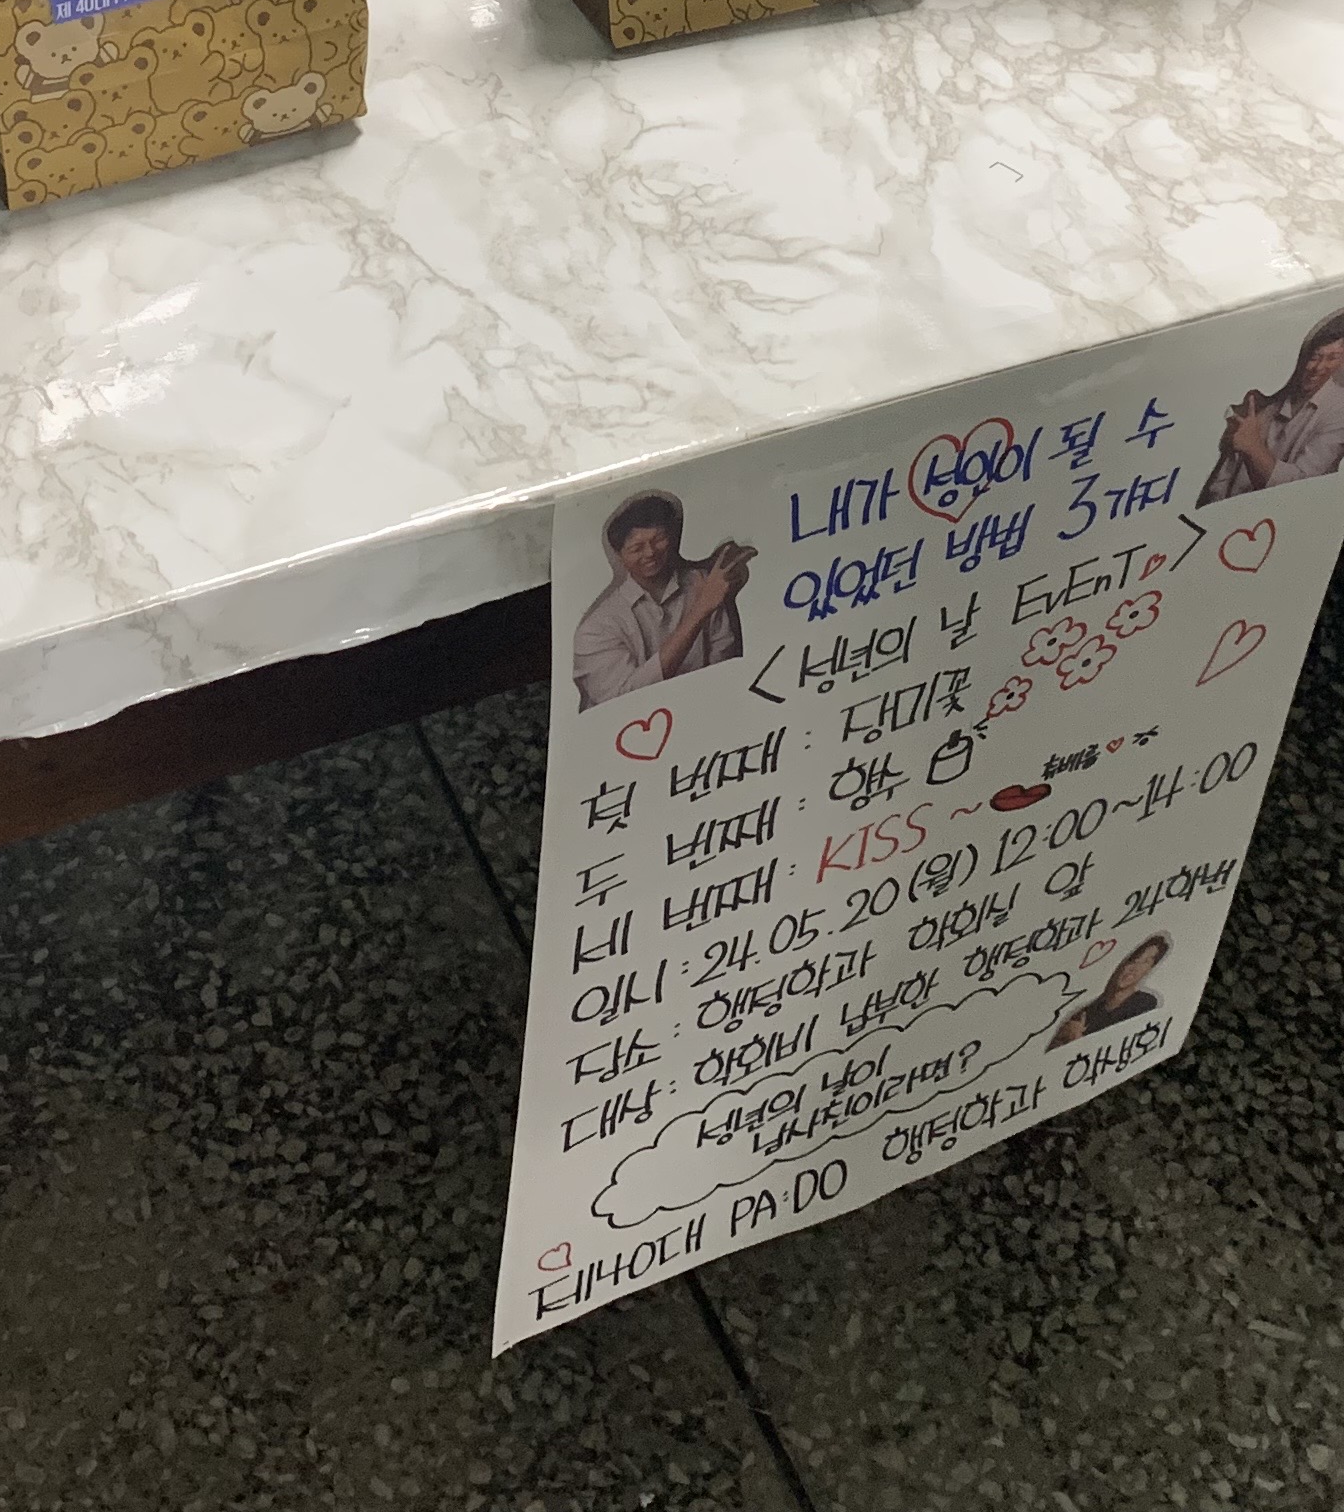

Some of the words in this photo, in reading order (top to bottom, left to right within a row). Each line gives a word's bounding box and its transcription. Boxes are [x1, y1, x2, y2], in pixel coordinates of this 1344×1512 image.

[55, 1, 72, 19] 제
[790, 468, 900, 543] 내가
[922, 426, 1043, 507] 성인이
[1048, 411, 1106, 470] 될
[1125, 397, 1175, 448] 수
[783, 538, 924, 622] 있었던
[945, 503, 1036, 573] 방법
[939, 591, 982, 650] 날
[580, 780, 637, 835] 첫
[840, 666, 973, 744] 장미꽃
[573, 909, 634, 975] 세
[814, 802, 933, 884] KISS
[574, 853, 628, 908] 두
[828, 751, 911, 811] 향수
[693, 1013, 820, 1088] 학회비
[841, 967, 940, 1038] 납부한
[962, 906, 1103, 983] 행정학과
[1110, 858, 1238, 931] 24학번
[695, 939, 878, 1033] 행정학과
[907, 883, 1022, 952] 학회실
[1043, 851, 1096, 903] 앞
[696, 1083, 807, 1150] 성년의
[820, 1043, 891, 1094] 날이
[729, 1158, 848, 1239] PA:DO
[881, 1074, 1047, 1165] 행정학과
[1061, 1016, 1174, 1090] 학생회
